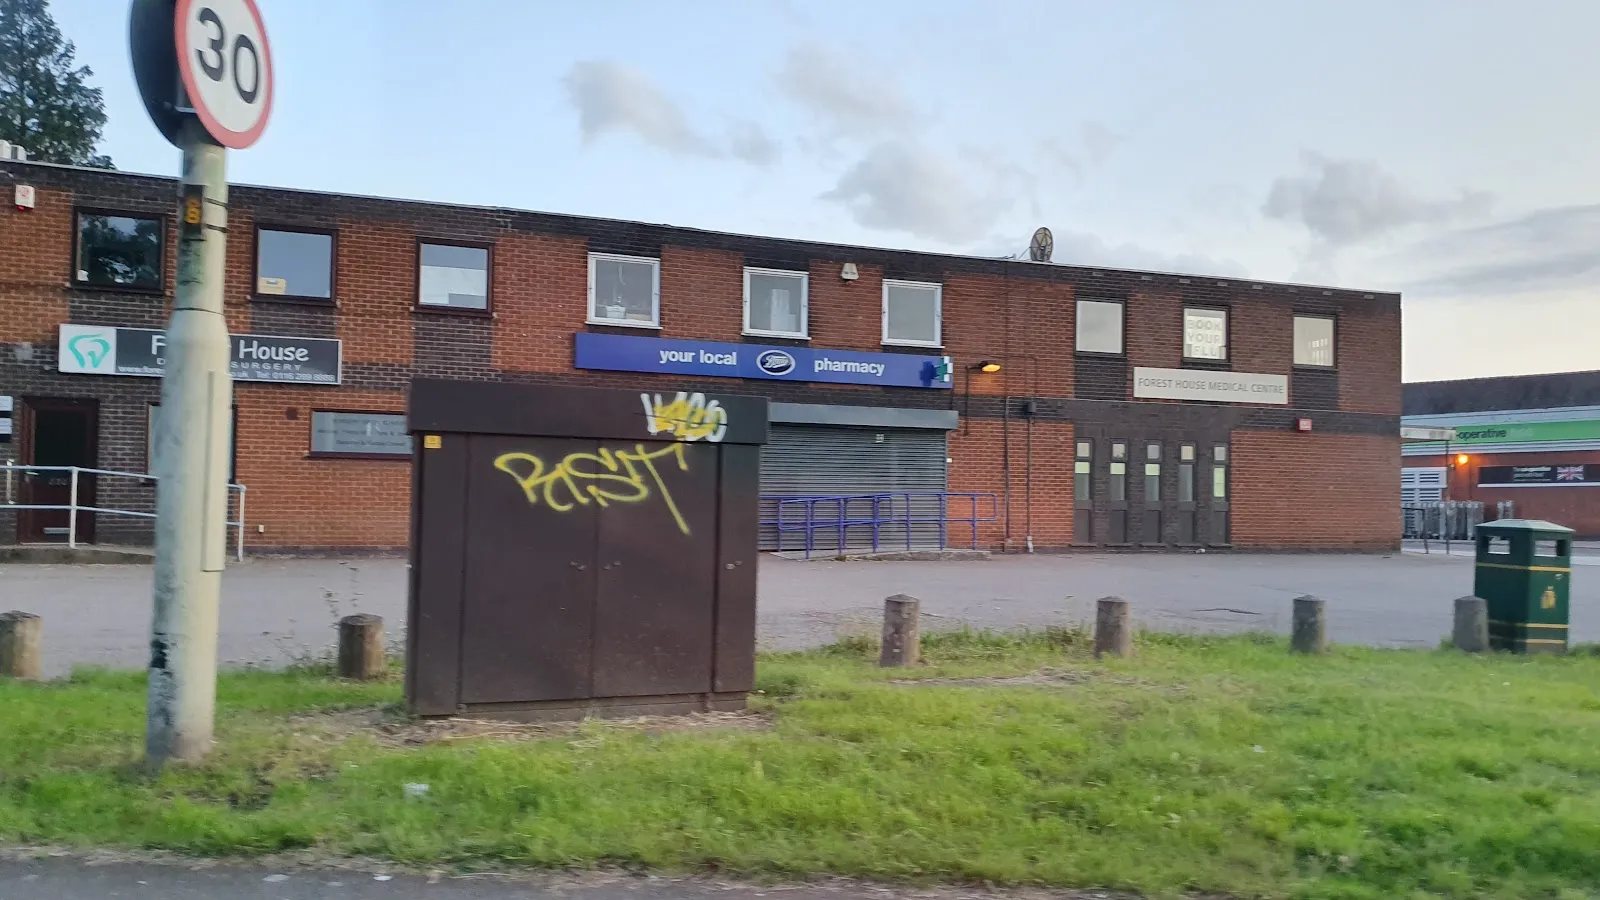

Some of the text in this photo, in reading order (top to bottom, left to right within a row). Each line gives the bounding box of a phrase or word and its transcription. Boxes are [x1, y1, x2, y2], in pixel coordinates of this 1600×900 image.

[195, 7, 259, 104] 30
[1187, 319, 1222, 331] BOOK
[238, 339, 310, 361] House
[230, 361, 302, 371] SURGERY
[659, 350, 696, 364] your
[699, 350, 737, 366] local
[814, 357, 886, 377] pharmacy
[1137, 377, 1285, 394] FOREST HOUSE MEDICAL CENTRE
